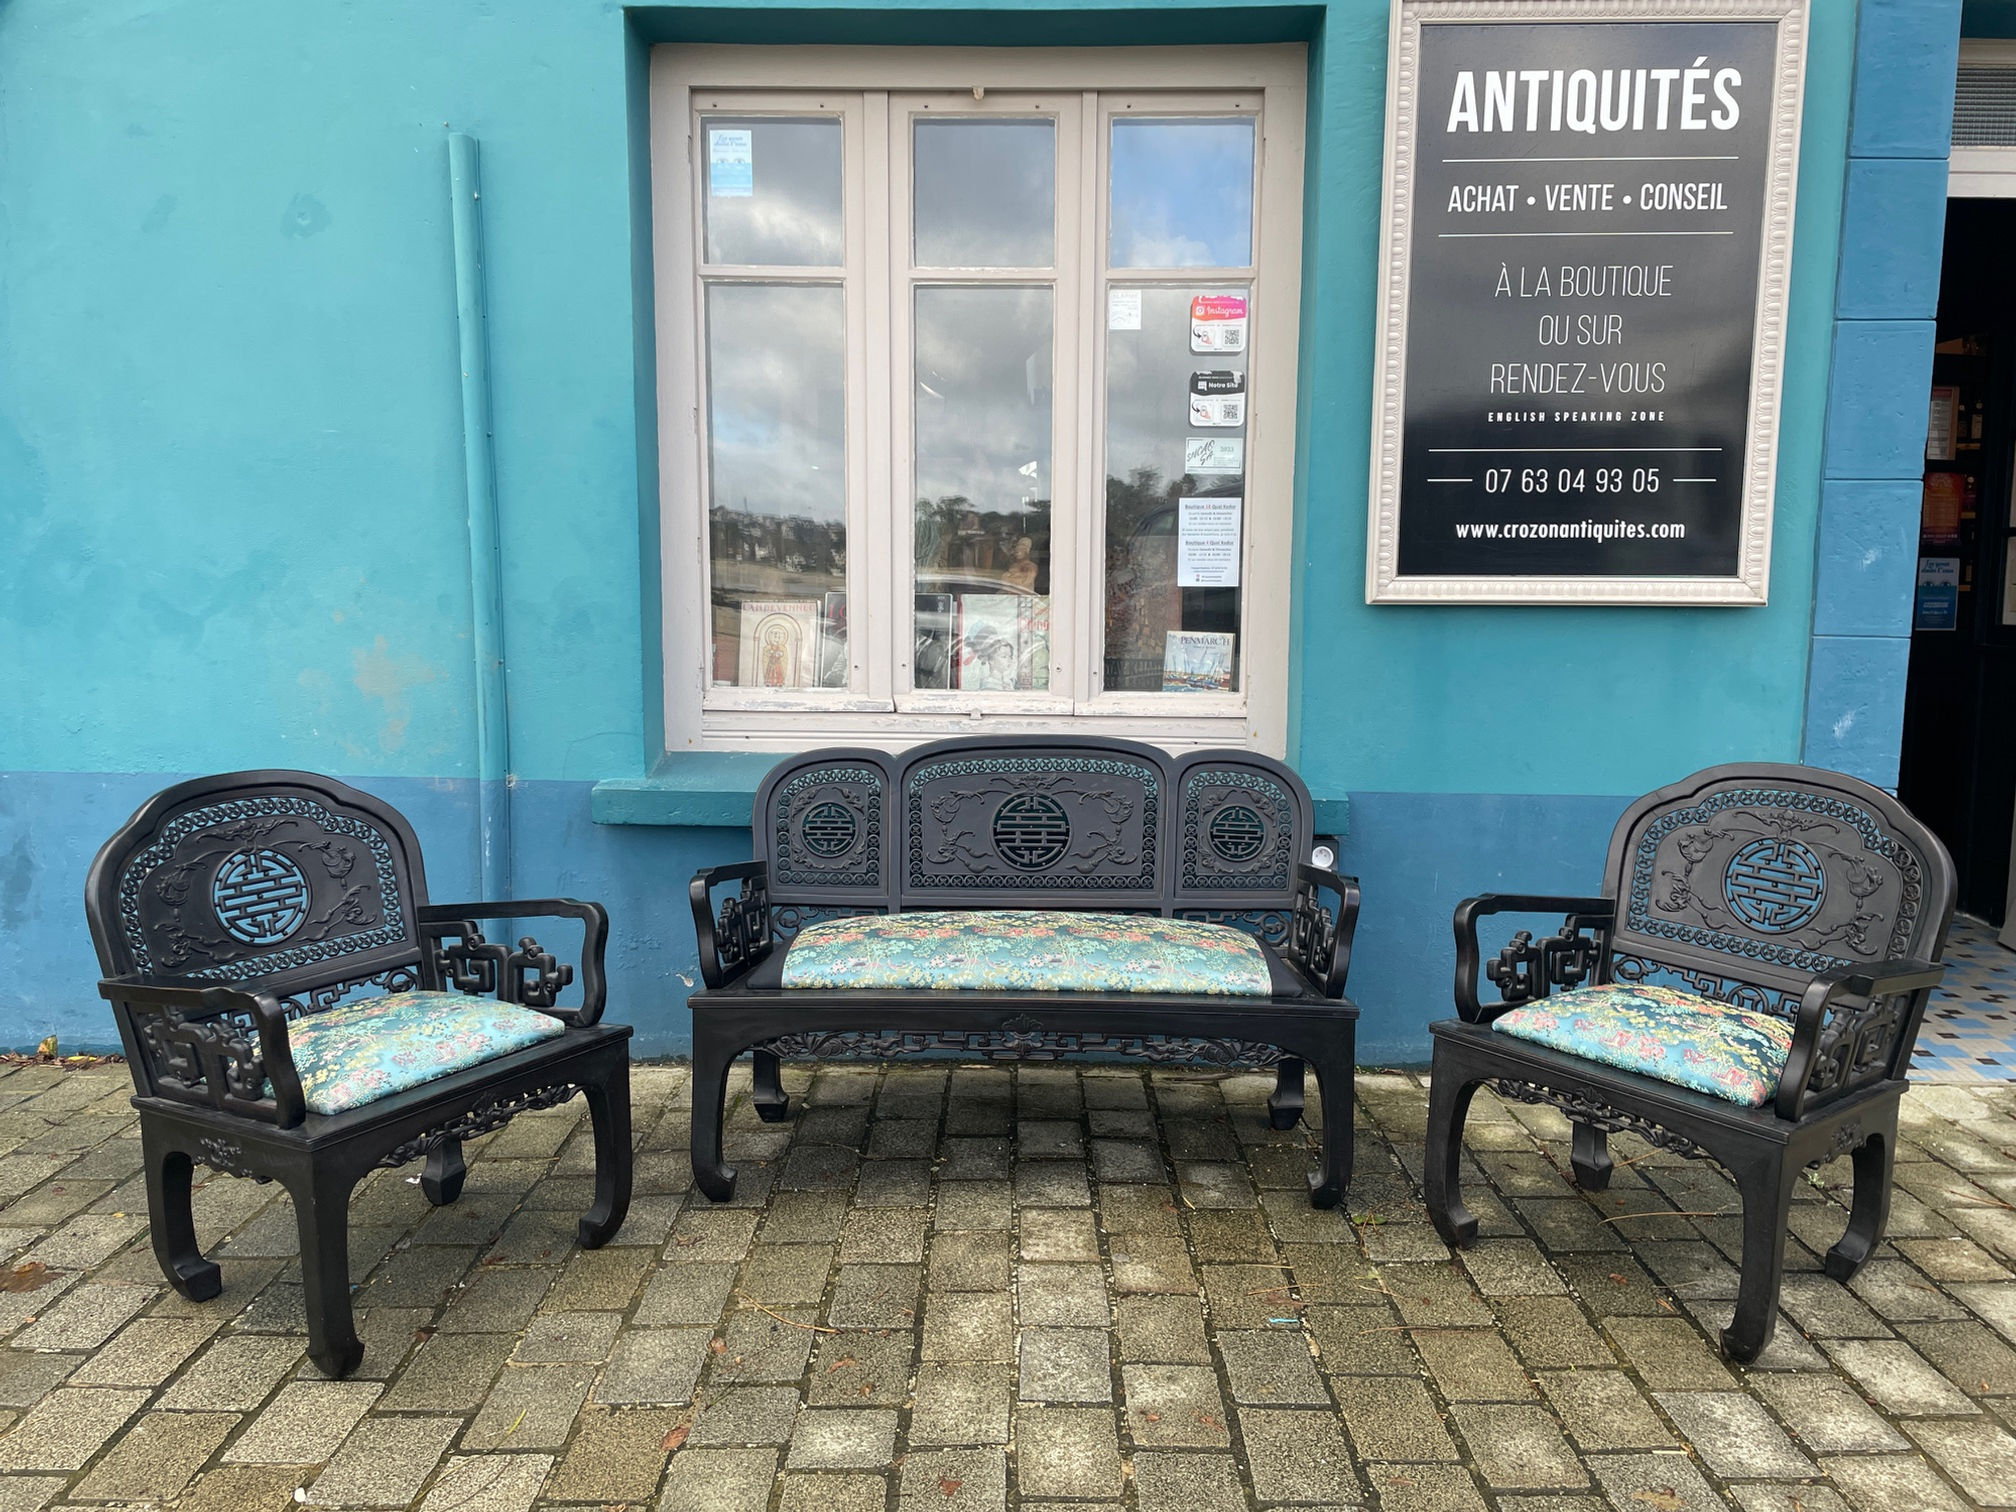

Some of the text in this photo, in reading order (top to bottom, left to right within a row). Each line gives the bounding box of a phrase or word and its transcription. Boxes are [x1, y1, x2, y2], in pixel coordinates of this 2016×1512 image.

[1446, 56, 1742, 134] ANTIQUITÉS
[1448, 182, 1728, 213] ACHAT VENTE CONSEIL
[1494, 261, 1674, 298] À LA BOUTIQUE
[1538, 314, 1623, 346] OU SUR
[1490, 361, 1667, 394] RENDEZ-VOUS
[1488, 411, 1665, 422] ENGLISH SPEAKING ZONE
[1485, 468, 1660, 493] 07 63 04 93 05
[1456, 519, 1686, 543] www.crozonantiquites.com
